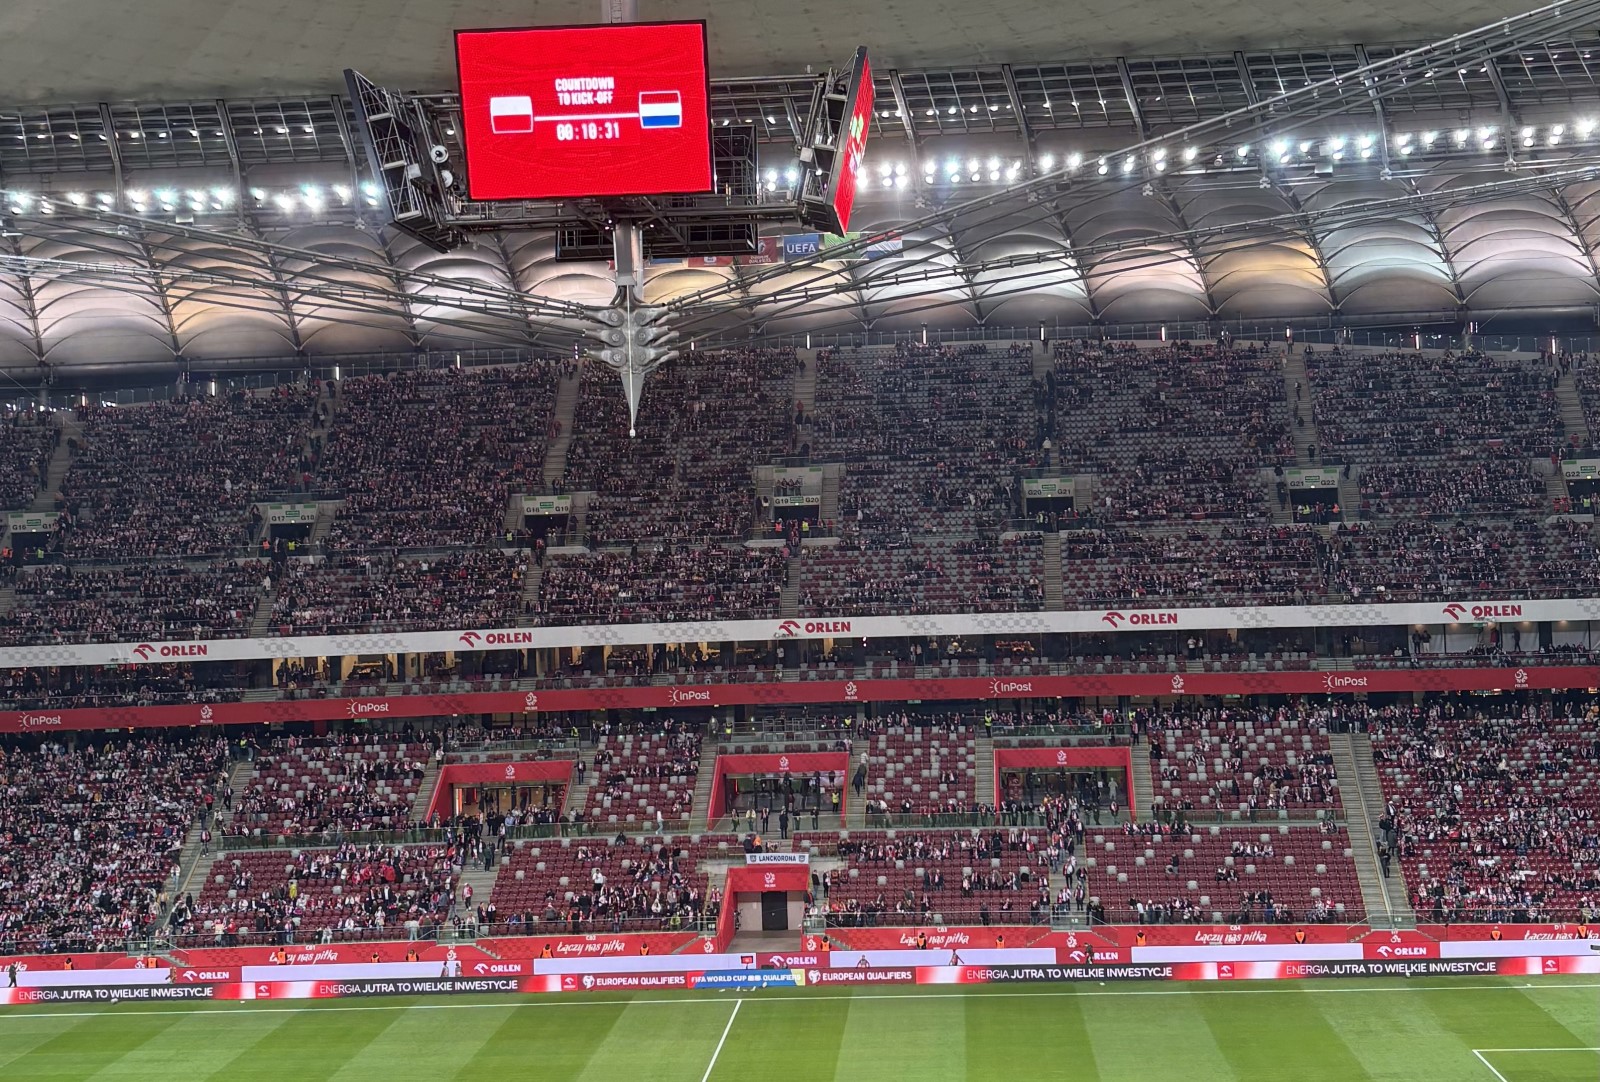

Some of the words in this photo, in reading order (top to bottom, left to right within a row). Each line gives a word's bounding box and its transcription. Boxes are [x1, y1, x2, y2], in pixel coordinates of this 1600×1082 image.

[555, 76, 615, 91] COUNTDOWN
[558, 92, 570, 105] TO
[571, 90, 614, 104] KICK-OFF
[556, 122, 620, 141] 00:10:31
[786, 244, 816, 253] UEFA
[1471, 605, 1522, 617] ORLEN
[1130, 613, 1178, 625] ORLEN
[805, 622, 851, 633] ORLEN
[486, 632, 532, 644] ORLEN
[160, 644, 208, 657] ORLEN
[1001, 681, 1032, 693] InPost
[1335, 676, 1368, 687] InPost
[680, 690, 710, 701] InPost
[358, 702, 389, 713] InPost
[30, 714, 62, 726] InPost
[928, 935, 945, 944] nas
[944, 932, 969, 947] piłka
[1224, 934, 1242, 943] nas
[585, 942, 602, 951] nas
[599, 939, 625, 954] piłka
[1394, 947, 1427, 956] ORLEN
[297, 953, 314, 962] nas
[313, 950, 338, 965] piłka
[786, 956, 817, 964] ORLEN
[1092, 952, 1118, 960] RLEN
[490, 964, 521, 972] ORLEN
[967, 970, 1009, 980] ENERGIA
[1011, 969, 1044, 979] JUTRA
[1046, 969, 1061, 978] TO
[1062, 968, 1104, 978] WIELKIE
[1107, 967, 1172, 977] INWESTYCJE
[1286, 965, 1329, 975] ENERGIA
[1331, 964, 1365, 974] JUTRA
[1368, 964, 1382, 973] TO
[1384, 963, 1427, 973] WIELKIE
[1429, 962, 1496, 972] INWESTYCJE
[199, 972, 229, 980] ORLEN
[596, 976, 638, 986] EUROPEAN
[640, 975, 685, 985] QUALIFIERS
[823, 972, 864, 981] EUROPEAN
[867, 971, 912, 981] QUALIFIERS
[320, 984, 360, 994] ENERGIA
[362, 983, 395, 994] JUTRA
[397, 983, 411, 992] TO
[412, 982, 452, 992] WIELKIE
[455, 980, 518, 991] INWESTYCJE
[18, 989, 59, 1000] ENERGIA
[60, 989, 92, 1000] JUTRA
[94, 989, 108, 999] TO
[110, 988, 149, 998] WIELKIE
[151, 987, 213, 997] INWESTYCJE
